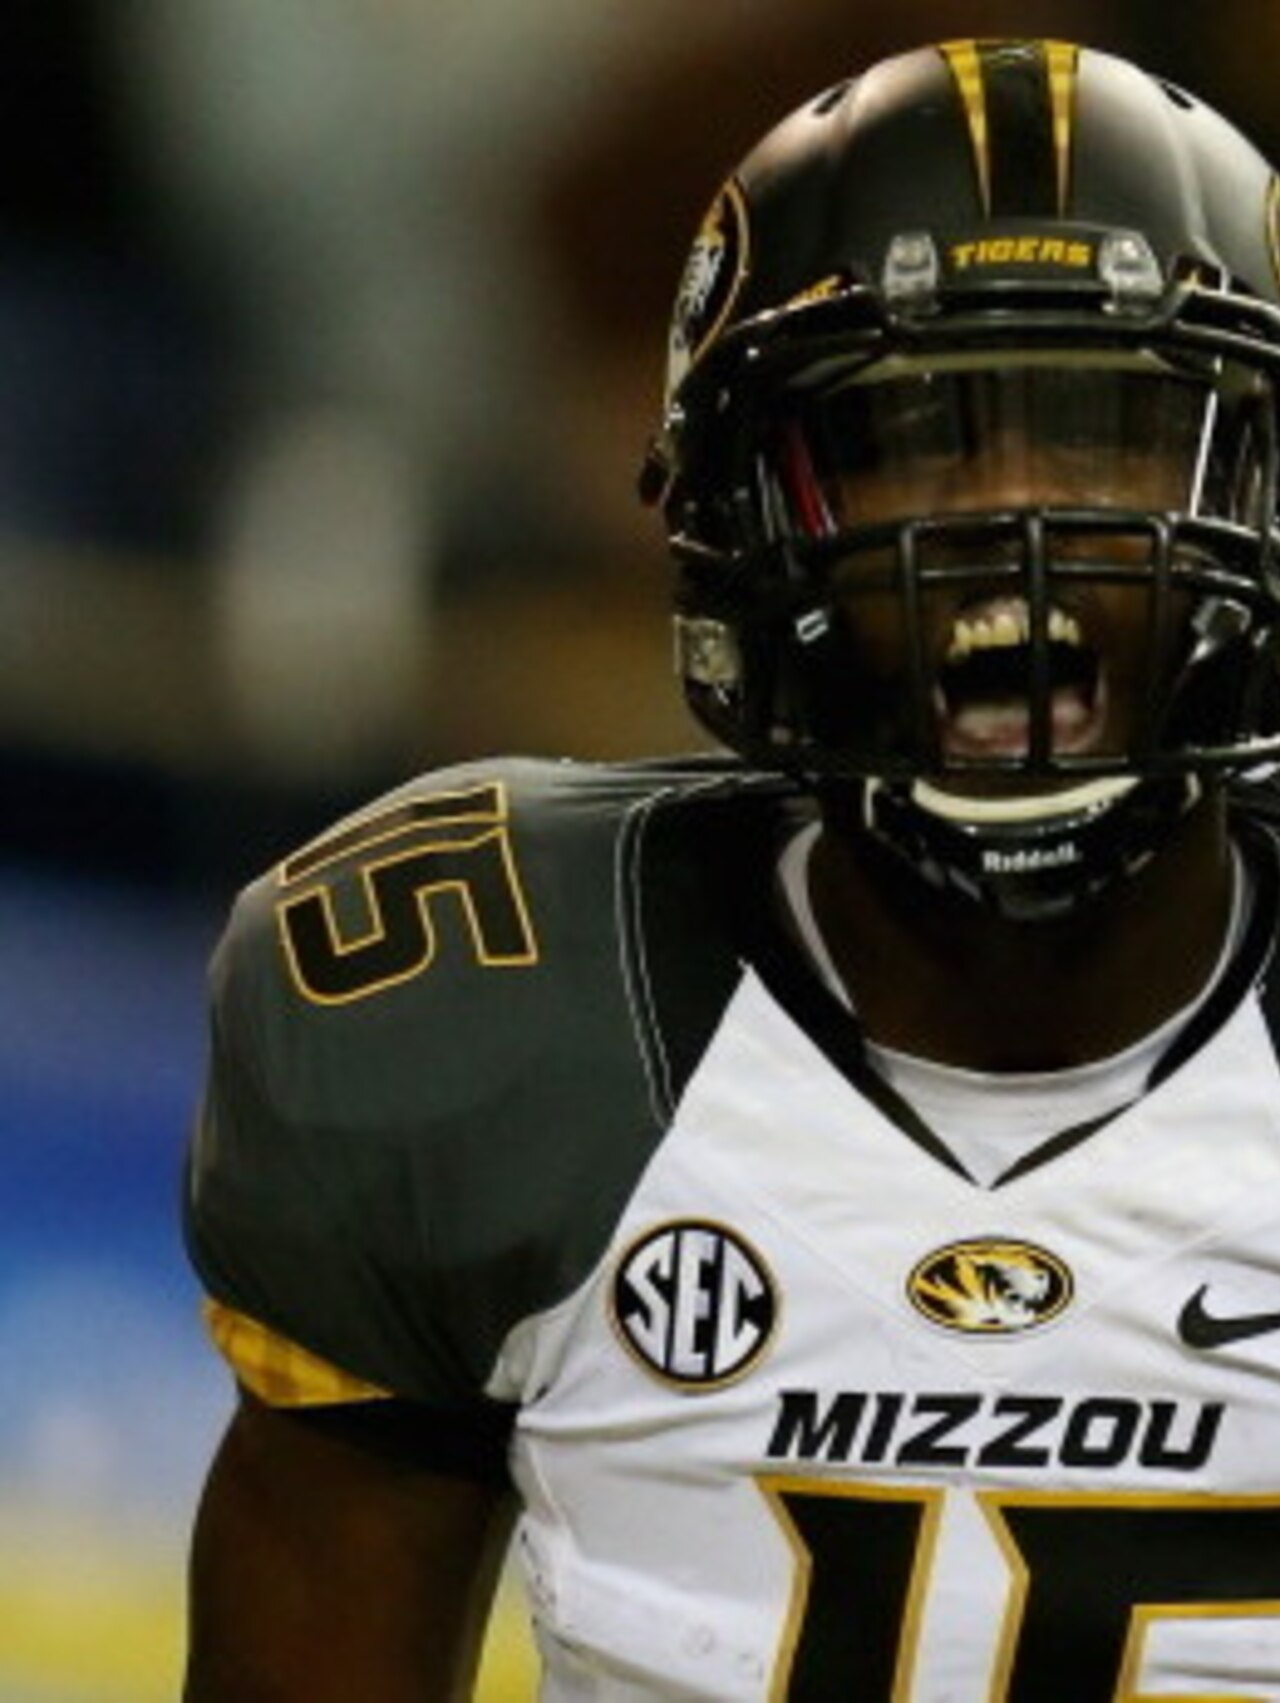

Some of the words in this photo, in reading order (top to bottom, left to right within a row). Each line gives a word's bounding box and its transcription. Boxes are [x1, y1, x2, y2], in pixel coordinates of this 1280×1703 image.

[950, 236, 1091, 270] TIGERS
[276, 781, 538, 1006] 15
[623, 1231, 765, 1377] SEC
[766, 1390, 1226, 1470] MIZZOU
